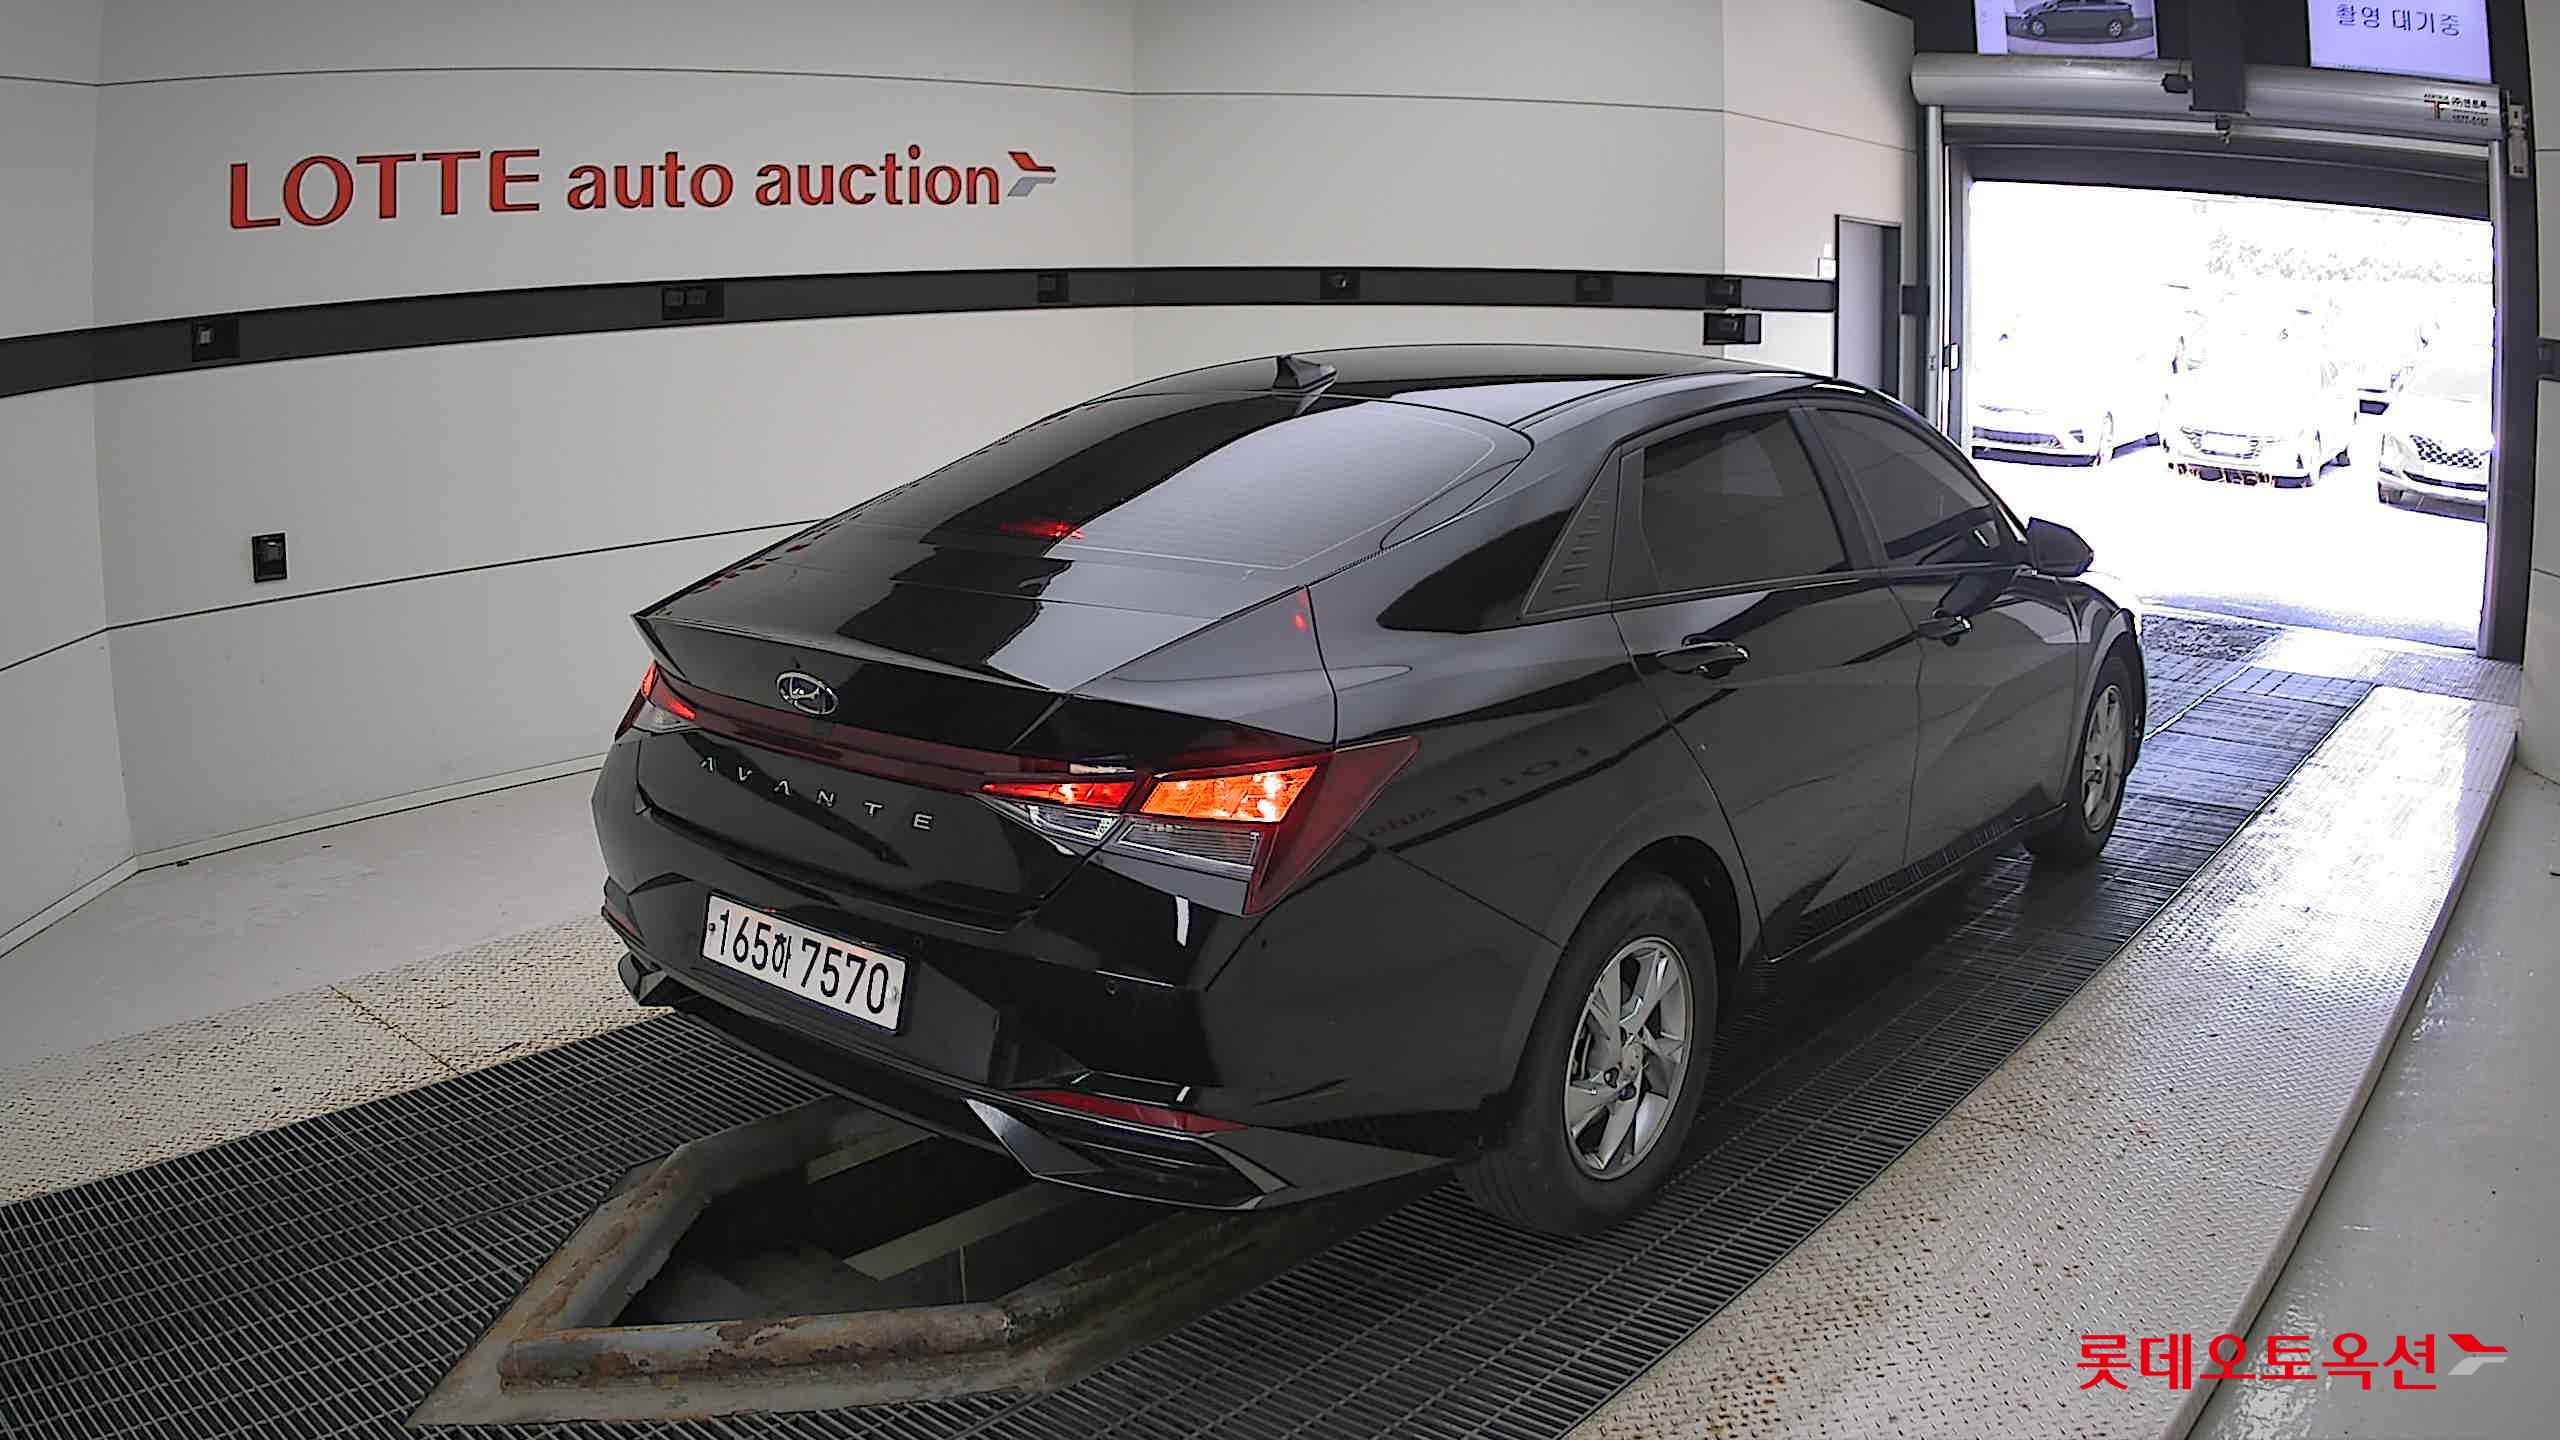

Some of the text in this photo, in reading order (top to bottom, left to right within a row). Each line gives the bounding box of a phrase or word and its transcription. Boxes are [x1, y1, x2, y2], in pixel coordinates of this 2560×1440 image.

[2336, 3, 2460, 37] 촬영 대기중
[230, 145, 1002, 230] LOTTE auto auction
[699, 756, 934, 831] AVANTE
[718, 908, 890, 1015] 165하 7570
